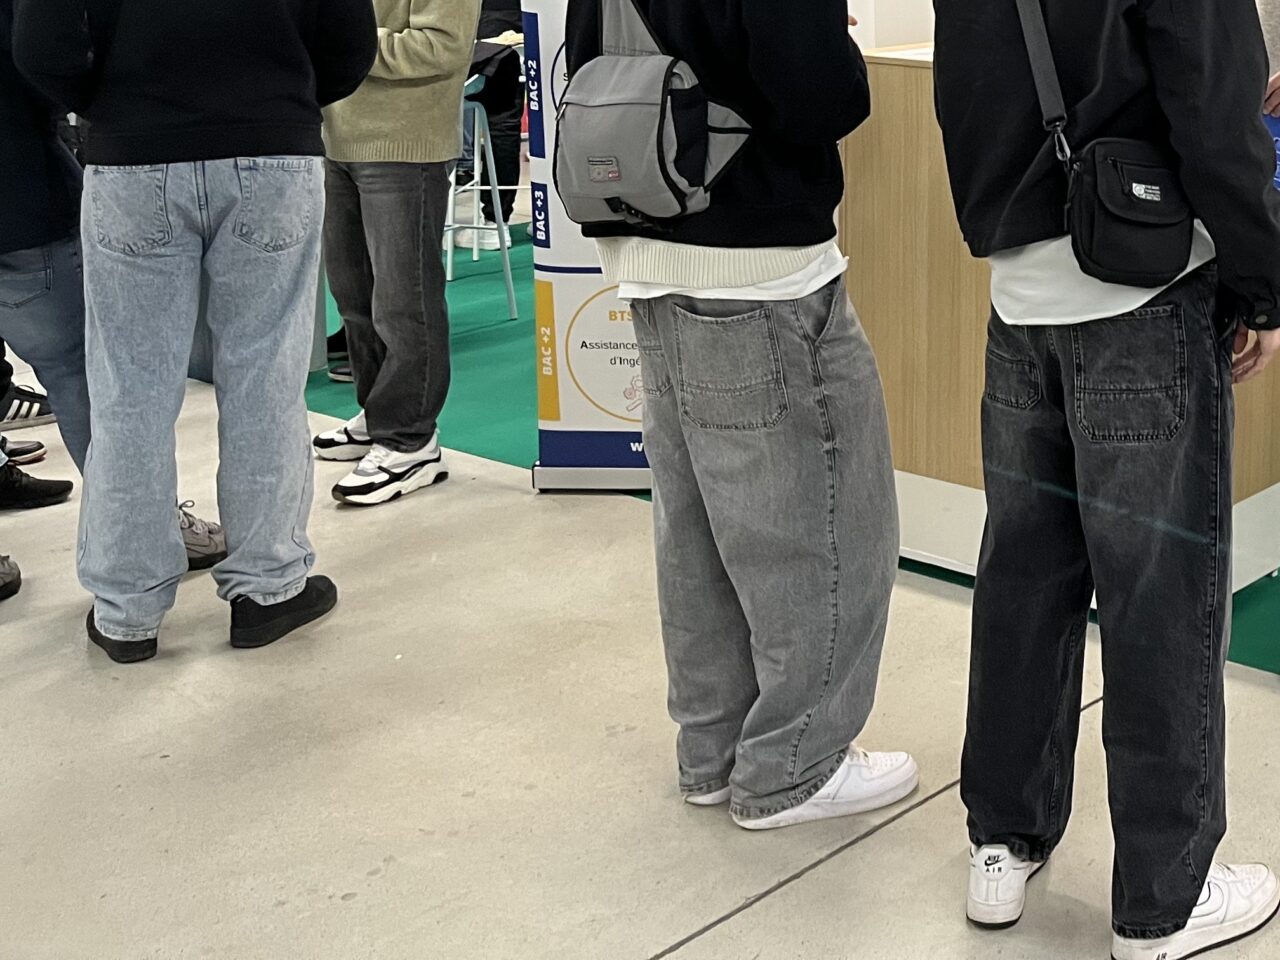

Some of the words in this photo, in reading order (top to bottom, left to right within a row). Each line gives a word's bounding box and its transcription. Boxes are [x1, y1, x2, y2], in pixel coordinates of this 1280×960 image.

[528, 60, 537, 78] +2
[528, 80, 540, 111] BAC
[534, 190, 544, 213] +3
[534, 215, 547, 240] BAC
[540, 327, 551, 344] +2
[580, 340, 639, 351] Assistance
[541, 346, 553, 376] BAC
[609, 355, 641, 368] d'Ingé
